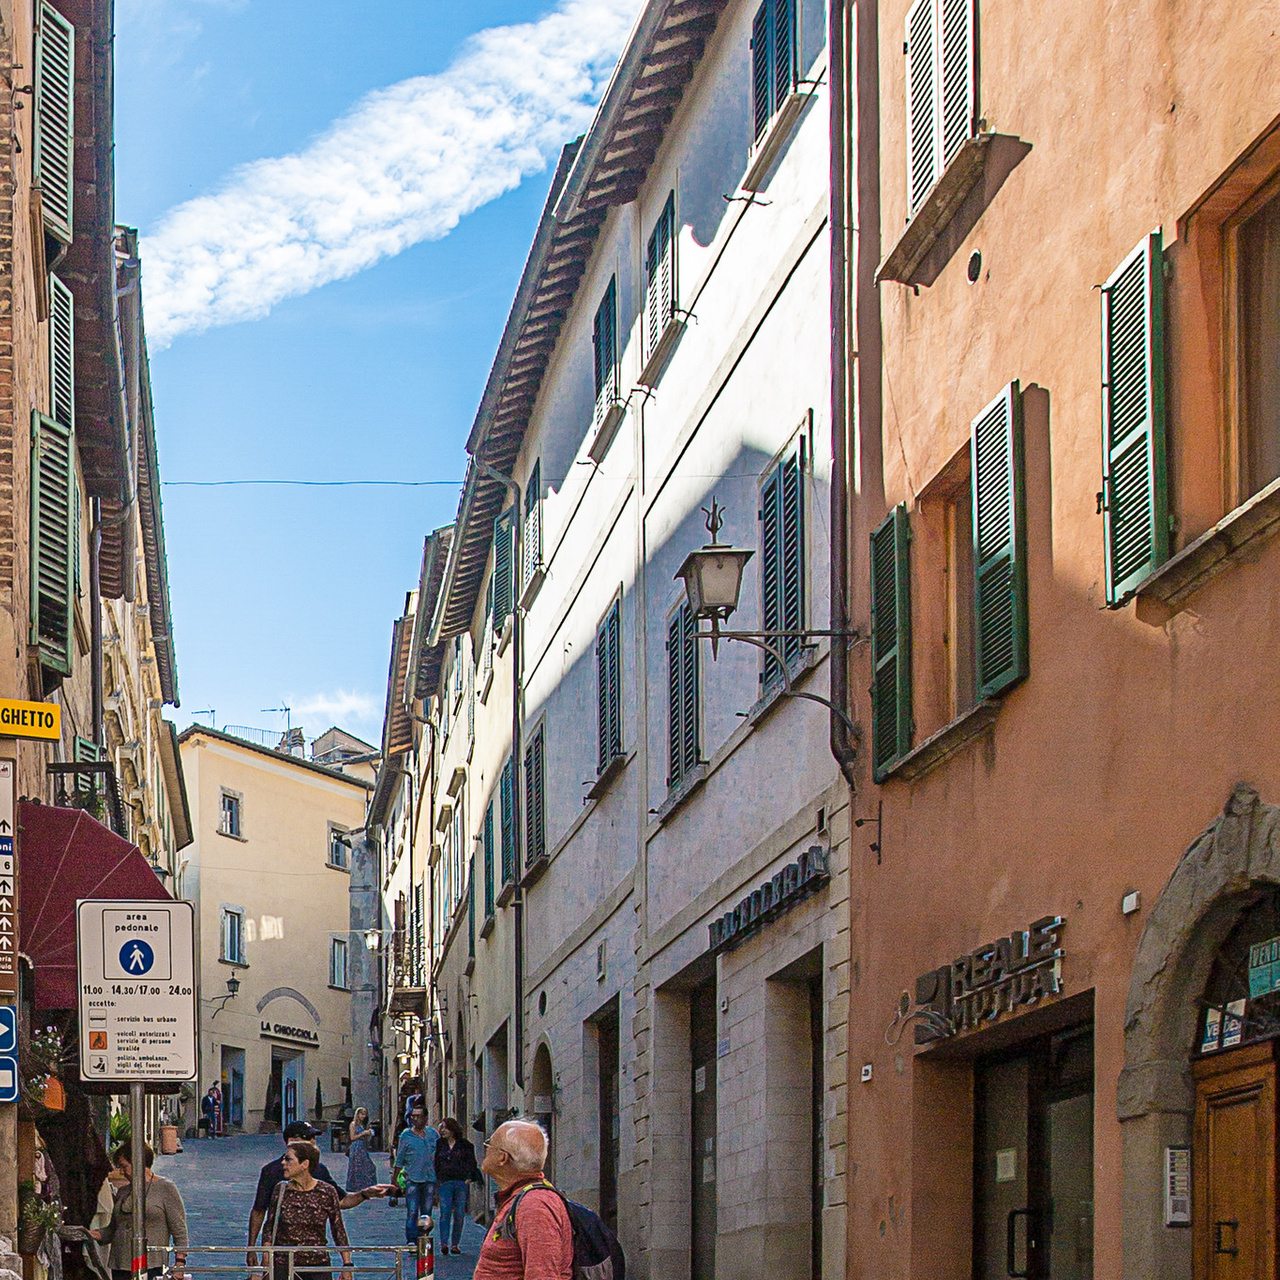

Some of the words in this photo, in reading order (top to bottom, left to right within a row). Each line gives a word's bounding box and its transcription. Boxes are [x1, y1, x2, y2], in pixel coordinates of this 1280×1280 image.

[4, 861, 11, 870] 6
[708, 846, 826, 950] MACELLERIA
[114, 923, 159, 933] pedonale
[951, 915, 1067, 997] REALE
[83, 984, 103, 995] 11.00
[168, 985, 192, 996] 24.00
[88, 1000, 117, 1008] eccetto:
[143, 1015, 154, 1023] bus
[156, 1015, 178, 1023] urbano
[139, 1030, 170, 1038] autorizzati
[260, 1020, 272, 1032] LA
[273, 1023, 319, 1042] CHIOCCIOLA
